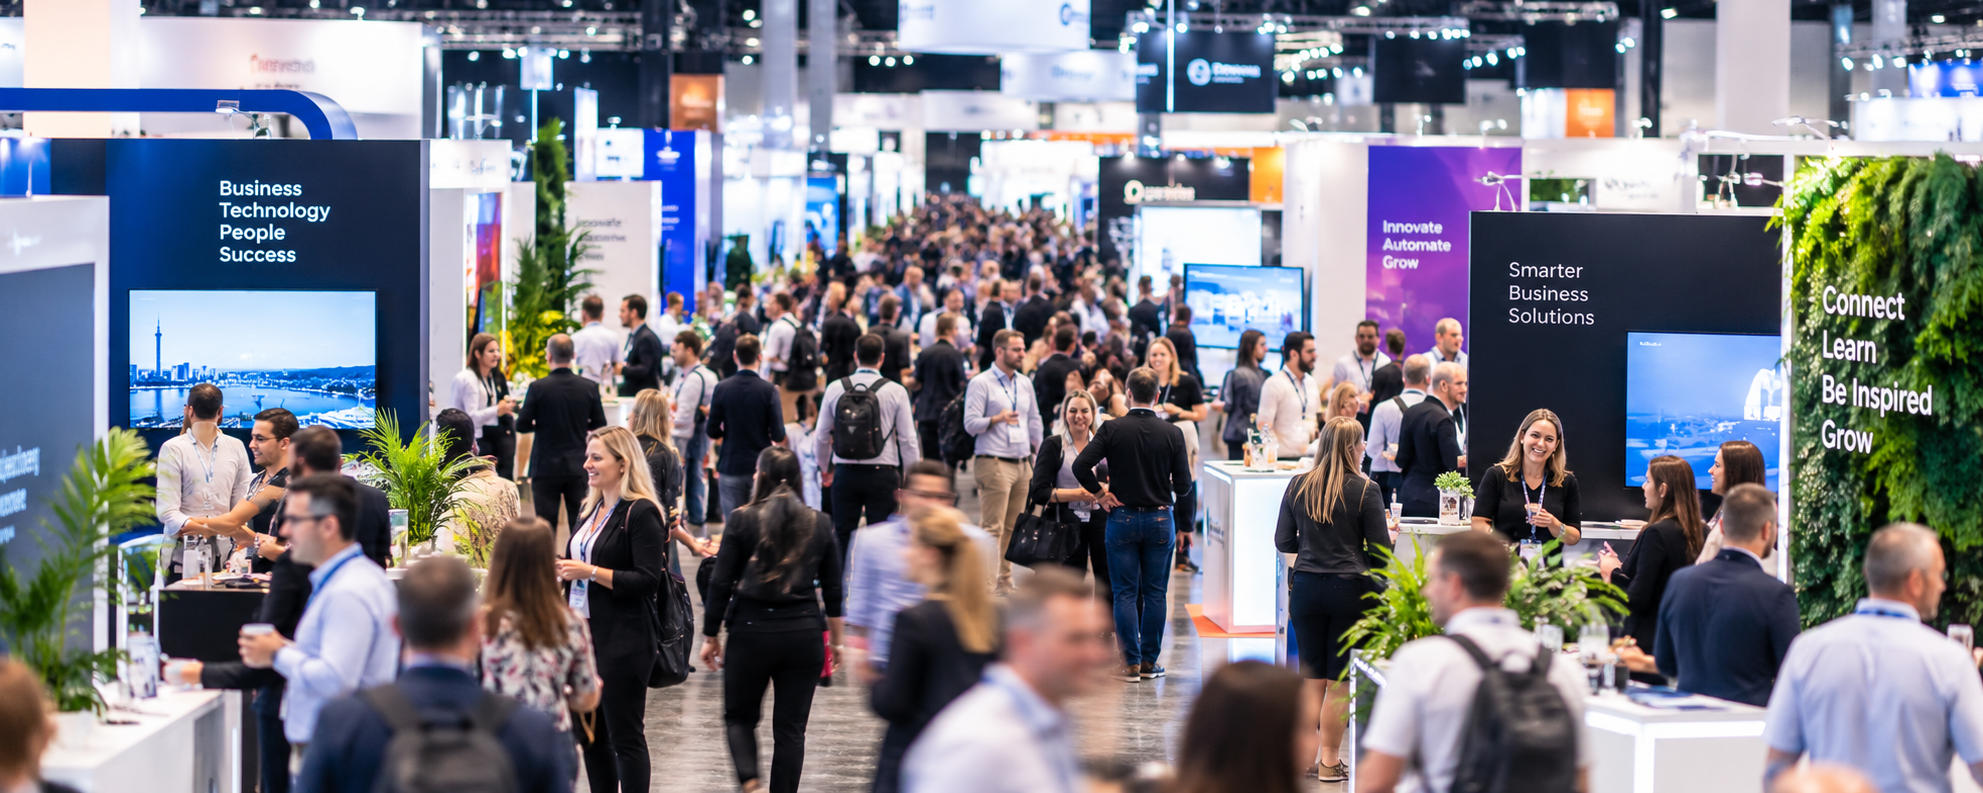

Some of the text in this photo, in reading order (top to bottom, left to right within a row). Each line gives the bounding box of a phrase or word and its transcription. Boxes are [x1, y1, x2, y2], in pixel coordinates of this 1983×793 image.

[219, 179, 303, 197] Business
[218, 201, 331, 222] Technology
[219, 223, 286, 244] People
[1382, 219, 1443, 235] Innovate
[1382, 237, 1452, 253] Automate
[219, 246, 297, 263] Success
[1382, 254, 1420, 270] Grow
[1508, 261, 1584, 279] Smarter
[1508, 284, 1589, 302] Business
[1822, 284, 1906, 321] Connect
[1508, 307, 1595, 326] Solutions
[1822, 329, 1877, 364] Learn
[1822, 374, 1933, 418] Be Inspired
[1821, 418, 1874, 454] Grow
